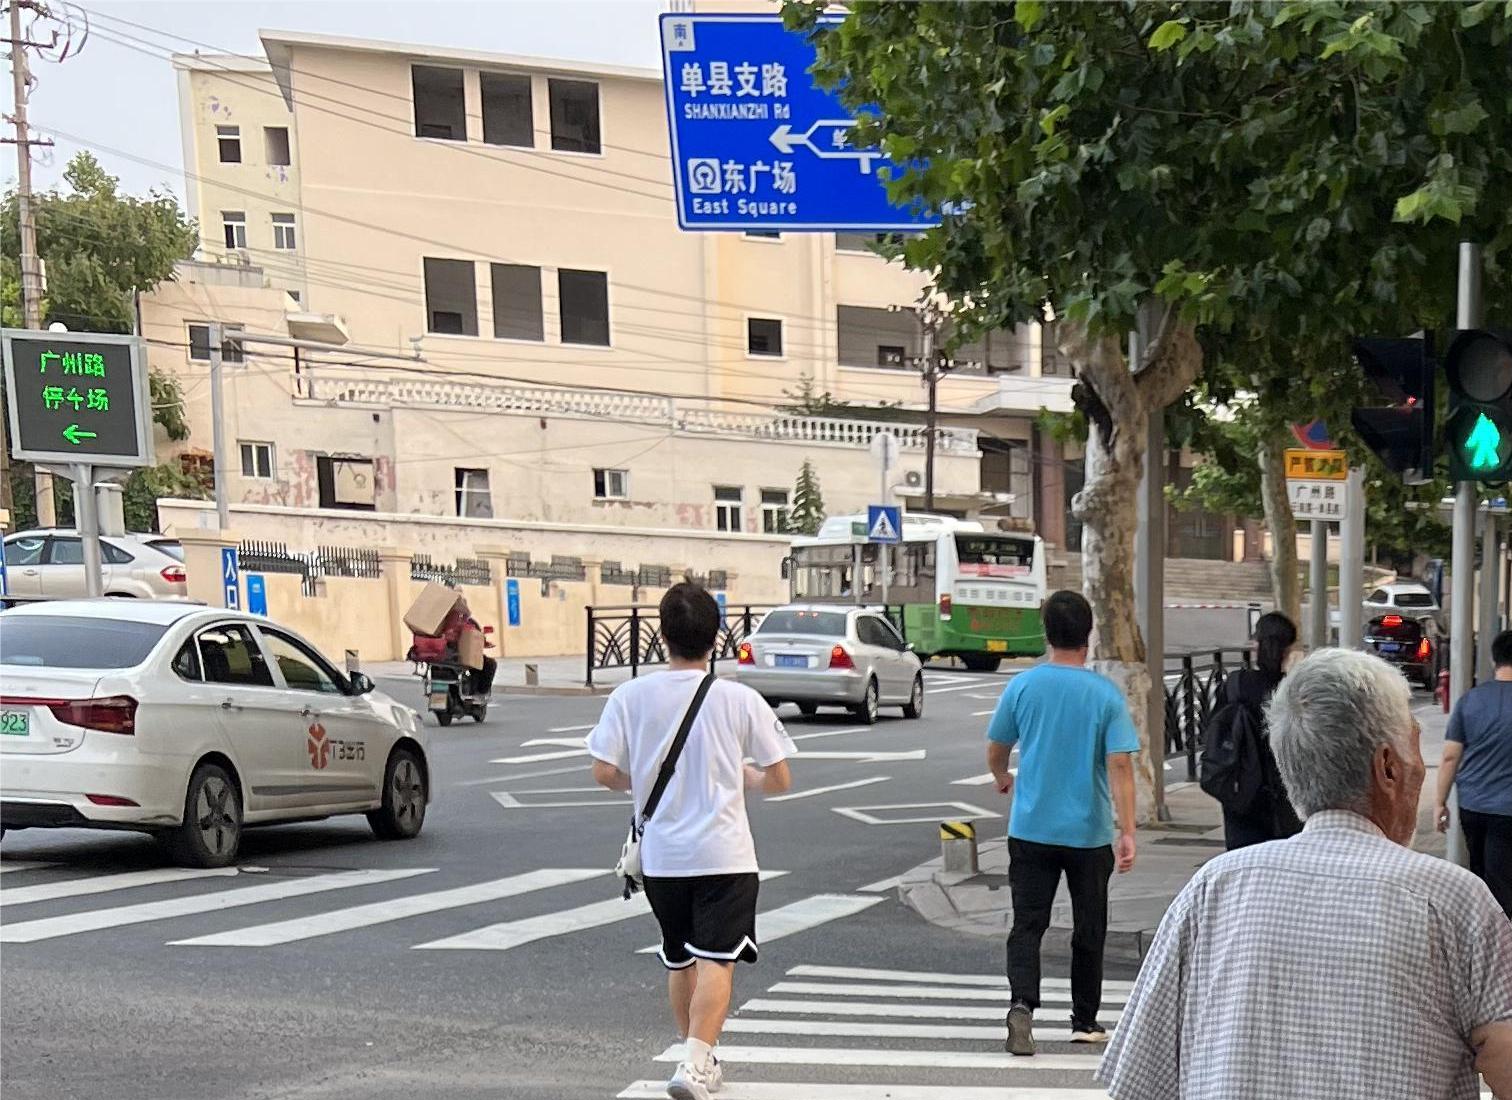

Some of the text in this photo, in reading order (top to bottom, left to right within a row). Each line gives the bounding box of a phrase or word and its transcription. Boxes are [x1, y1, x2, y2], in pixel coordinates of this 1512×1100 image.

[673, 23, 687, 40] 南
[680, 62, 788, 98] 单县支路
[684, 103, 790, 119] SHANXIANZHI Rd
[723, 159, 796, 194] 东广场
[693, 199, 797, 217] East Square
[40, 350, 105, 377] 广州路
[43, 385, 109, 411] 停车场
[224, 552, 238, 608] 入口
